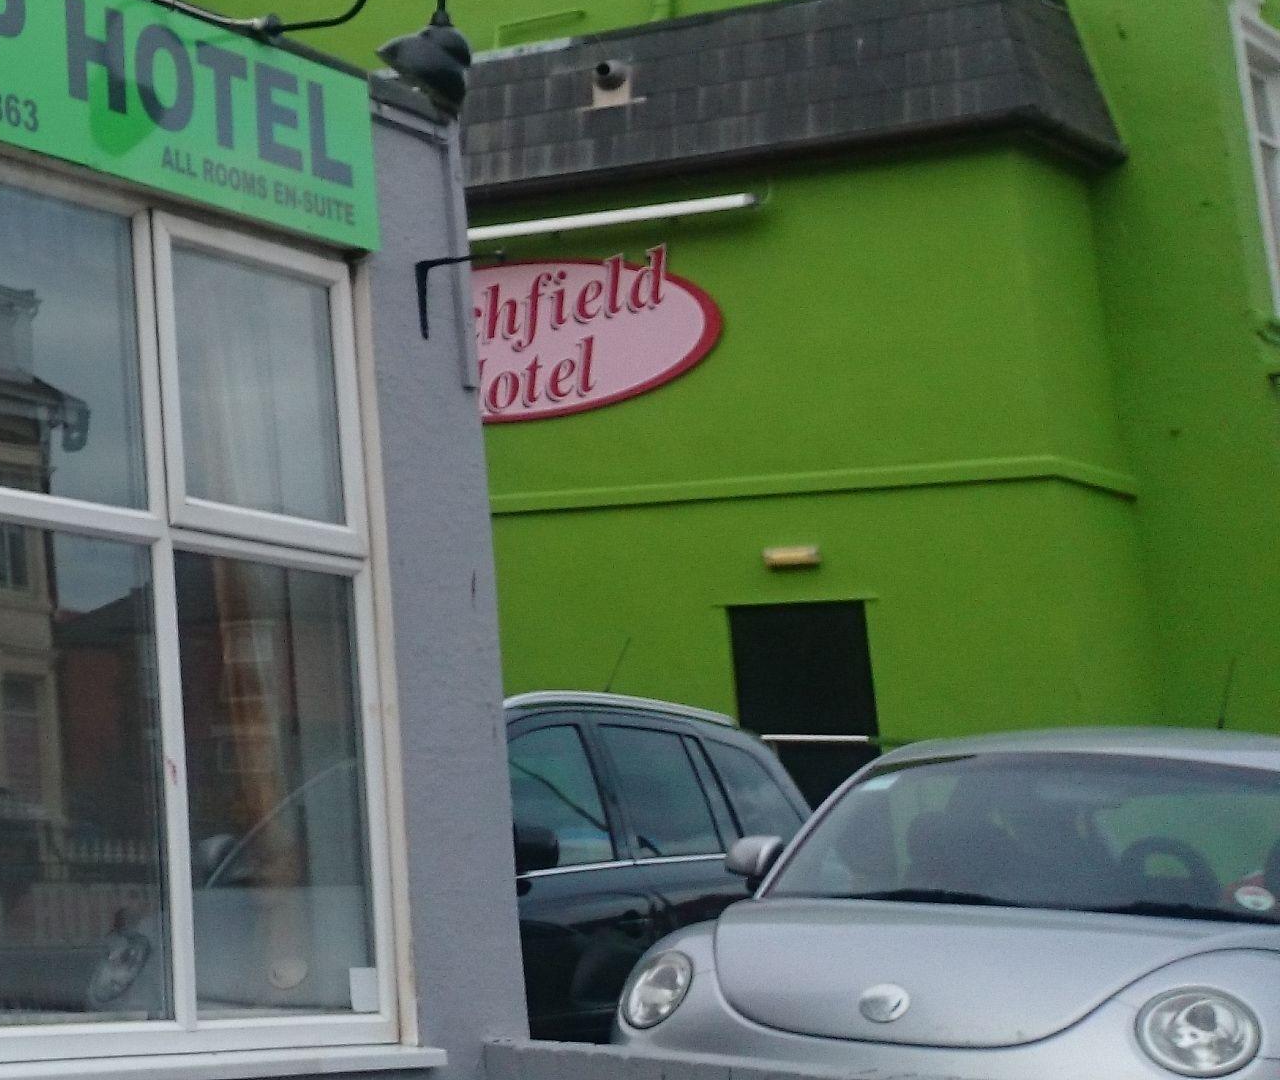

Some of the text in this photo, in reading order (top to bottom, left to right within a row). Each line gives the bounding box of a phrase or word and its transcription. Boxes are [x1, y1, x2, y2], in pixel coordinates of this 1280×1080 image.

[161, 146, 355, 226] ALL ROOMS EN-SUITE
[474, 243, 667, 351] hfield
[478, 335, 595, 411] otel
